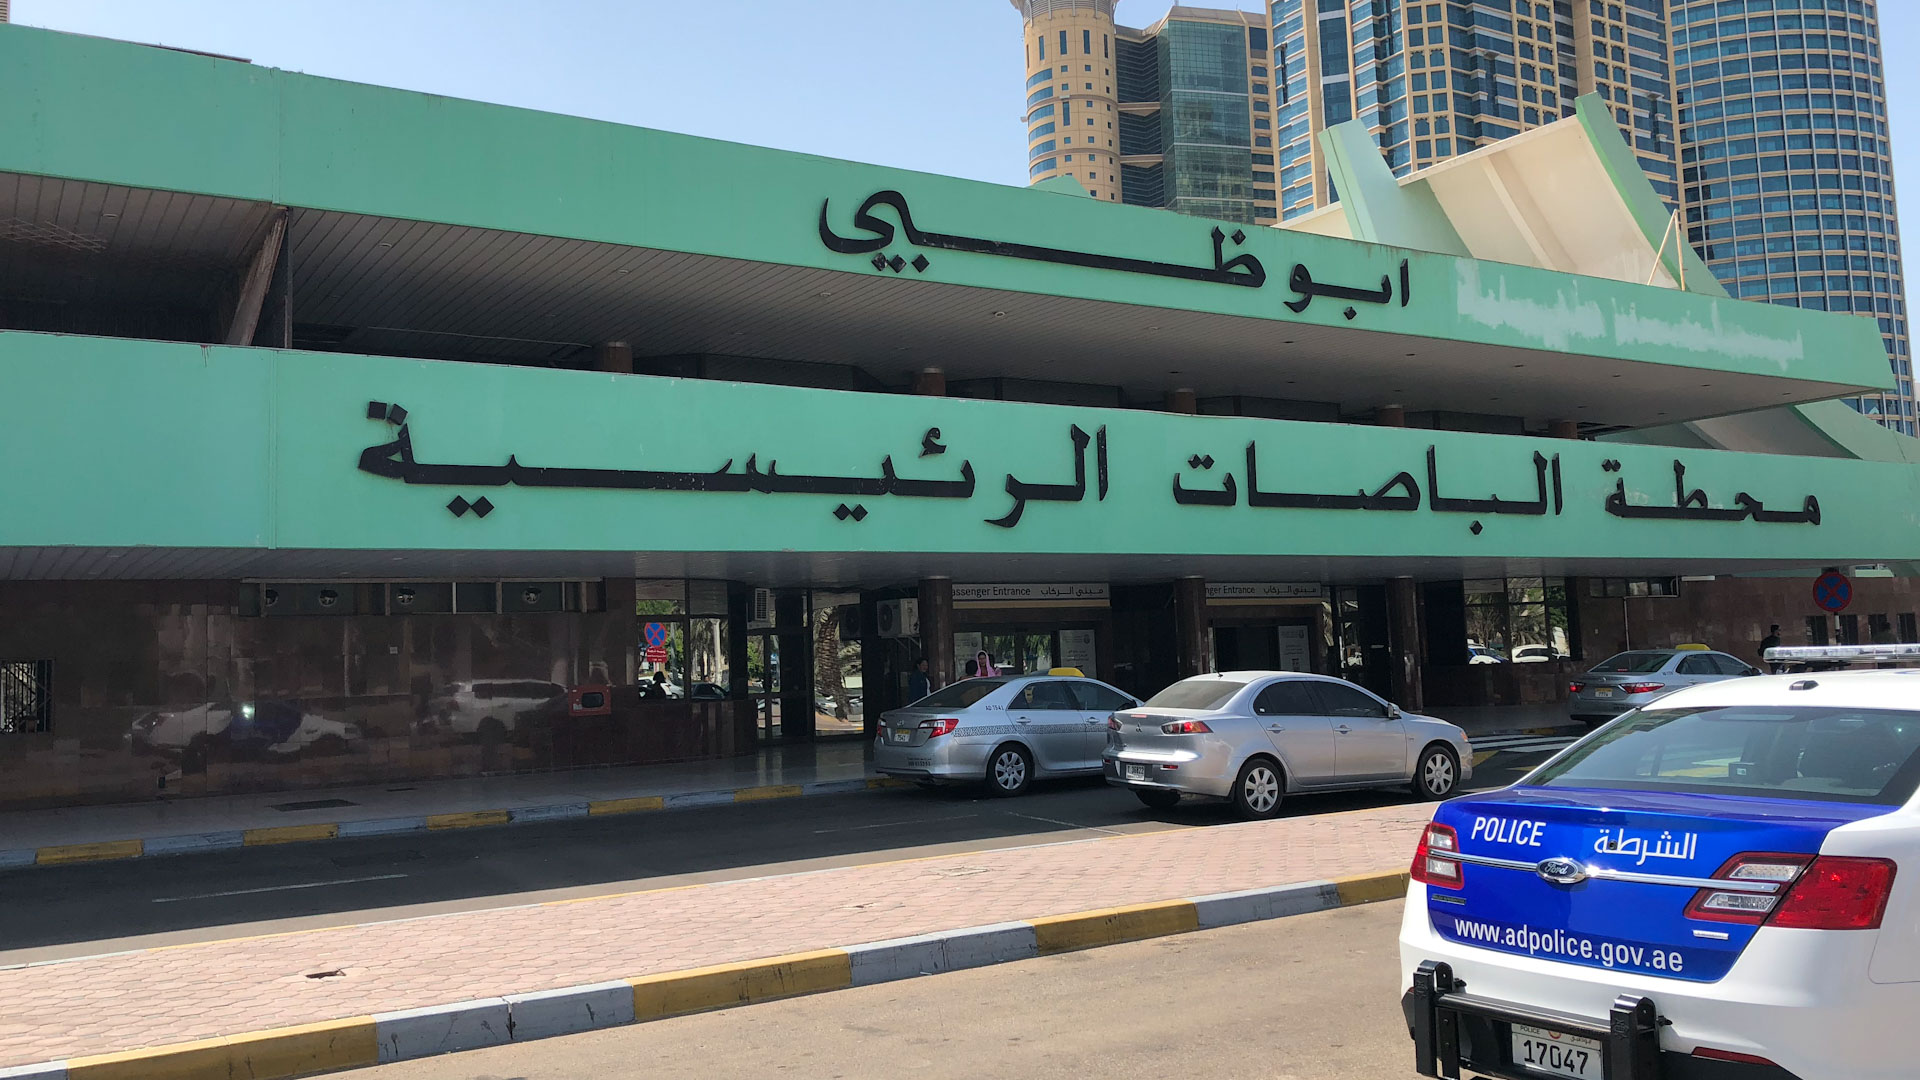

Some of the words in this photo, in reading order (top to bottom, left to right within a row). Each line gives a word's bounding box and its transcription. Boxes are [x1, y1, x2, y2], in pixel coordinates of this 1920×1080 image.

[357, 400, 1108, 529] الرئيسية
[1172, 440, 1563, 537] الباصات
[1601, 458, 1821, 526] محطة
[952, 587, 991, 598] assenger
[993, 586, 1031, 596] Entrance
[1041, 586, 1074, 597] الركاب
[1224, 585, 1255, 595] Entrance
[1471, 816, 1547, 847] POLICE
[1594, 828, 1698, 866] الشرطة
[1544, 861, 1569, 875] Ford
[1455, 918, 1684, 972] www.adpolice.gov.ae
[1520, 1025, 1541, 1035] POLICE
[1523, 1039, 1589, 1075] 17047
